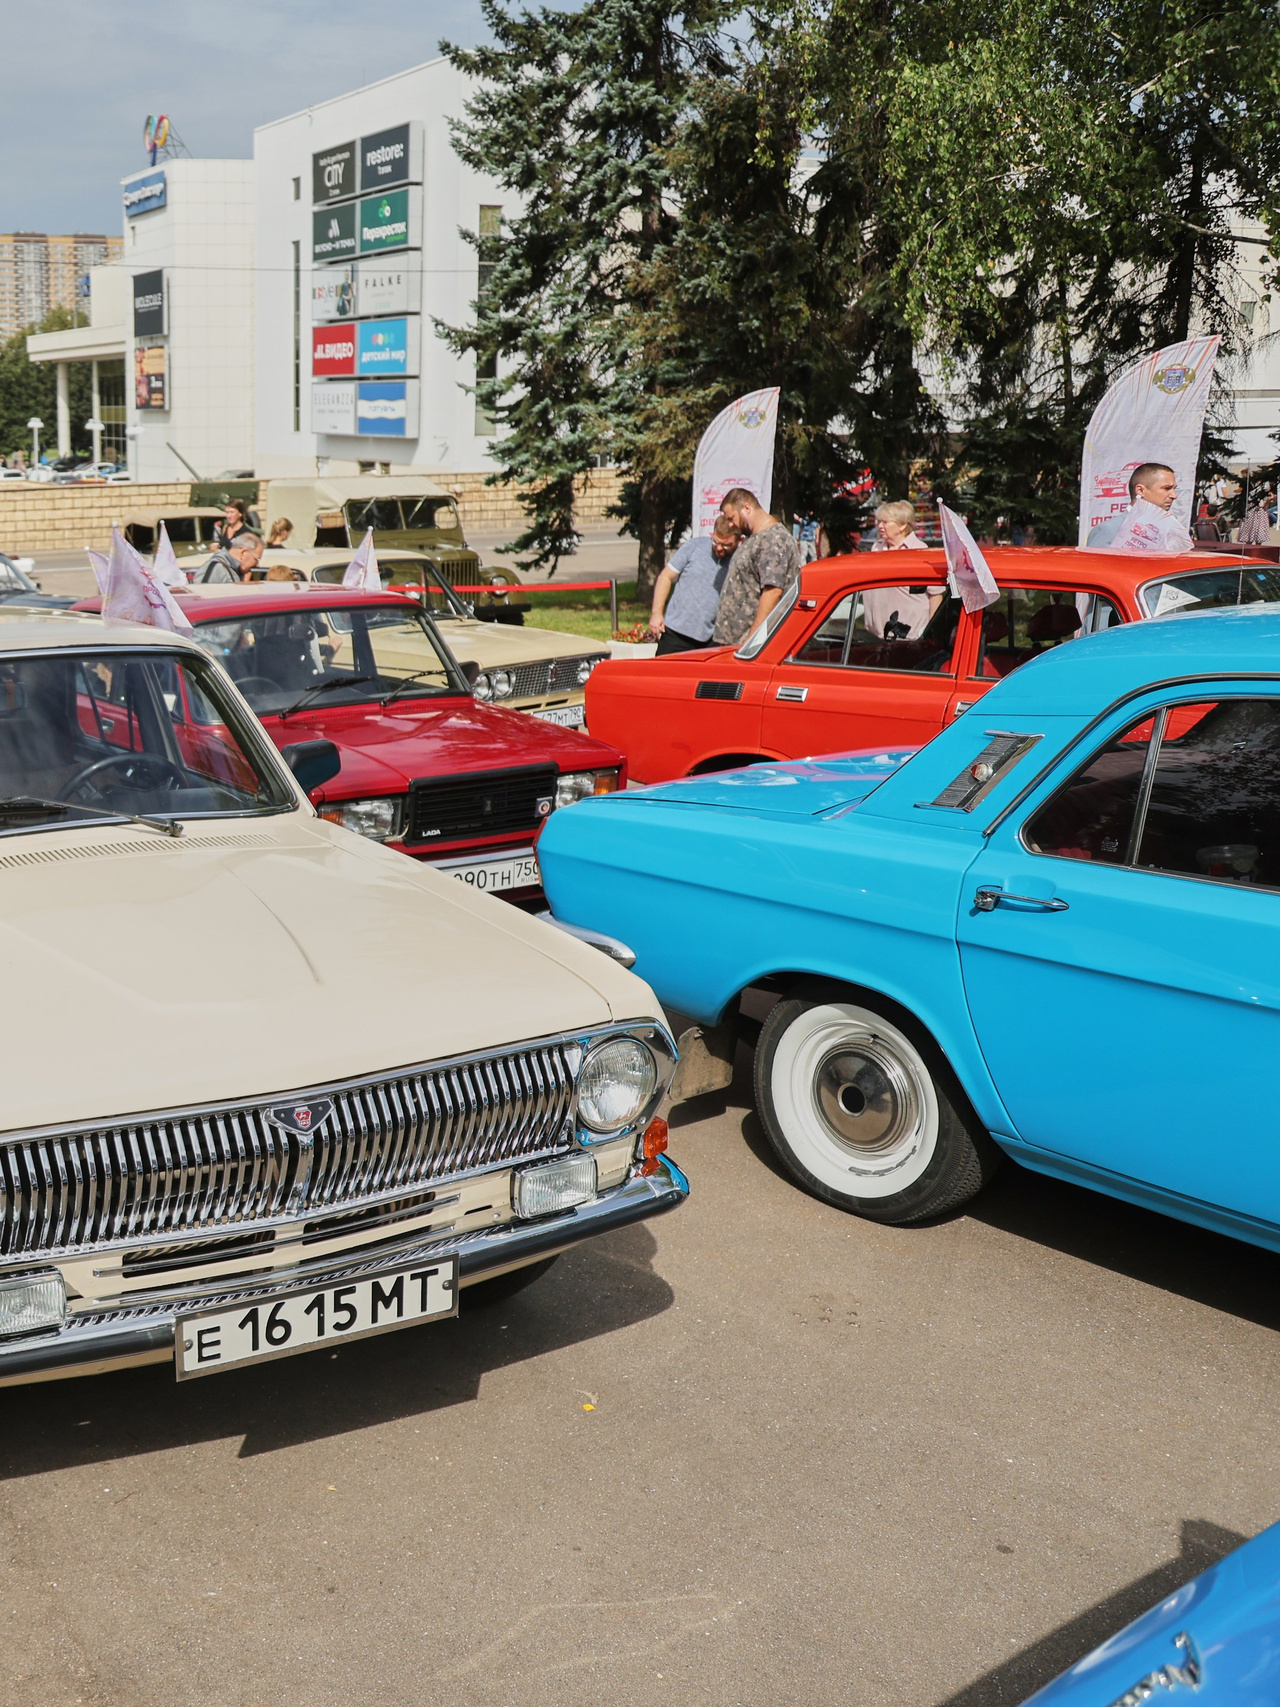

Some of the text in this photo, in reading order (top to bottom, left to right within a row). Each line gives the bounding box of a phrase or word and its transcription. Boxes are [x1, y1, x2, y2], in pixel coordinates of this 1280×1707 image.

[366, 143, 404, 167] restore:
[324, 162, 345, 187] CITY
[365, 274, 402, 288] FALKE
[361, 347, 406, 363] детский мир
[422, 829, 441, 837] LADA
